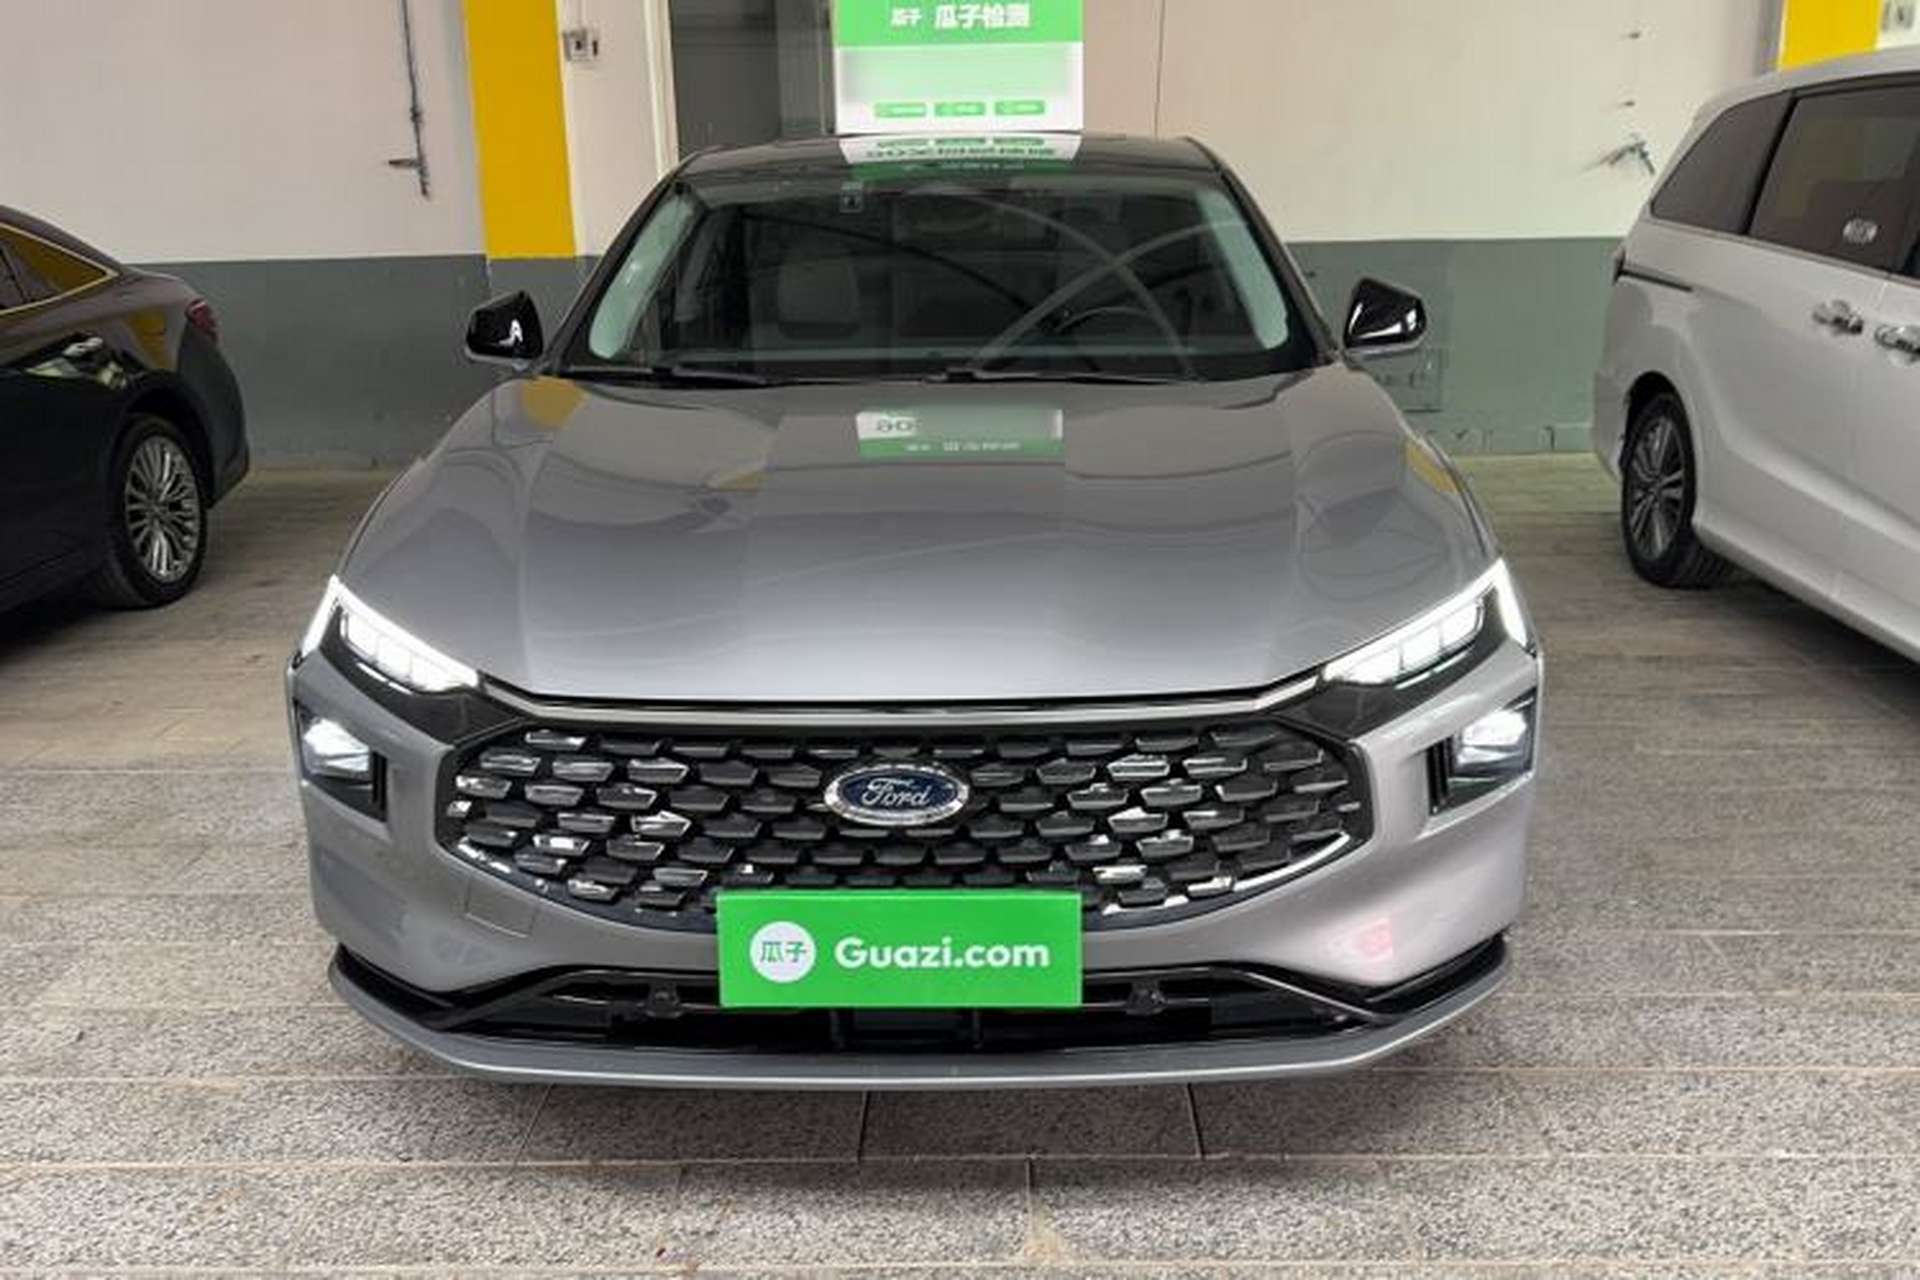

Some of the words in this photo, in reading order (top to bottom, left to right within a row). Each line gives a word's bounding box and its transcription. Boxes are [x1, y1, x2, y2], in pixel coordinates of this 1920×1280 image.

[861, 778, 931, 807] Ford
[759, 940, 807, 964] 瓜子
[834, 936, 1050, 969] Guazi.com
